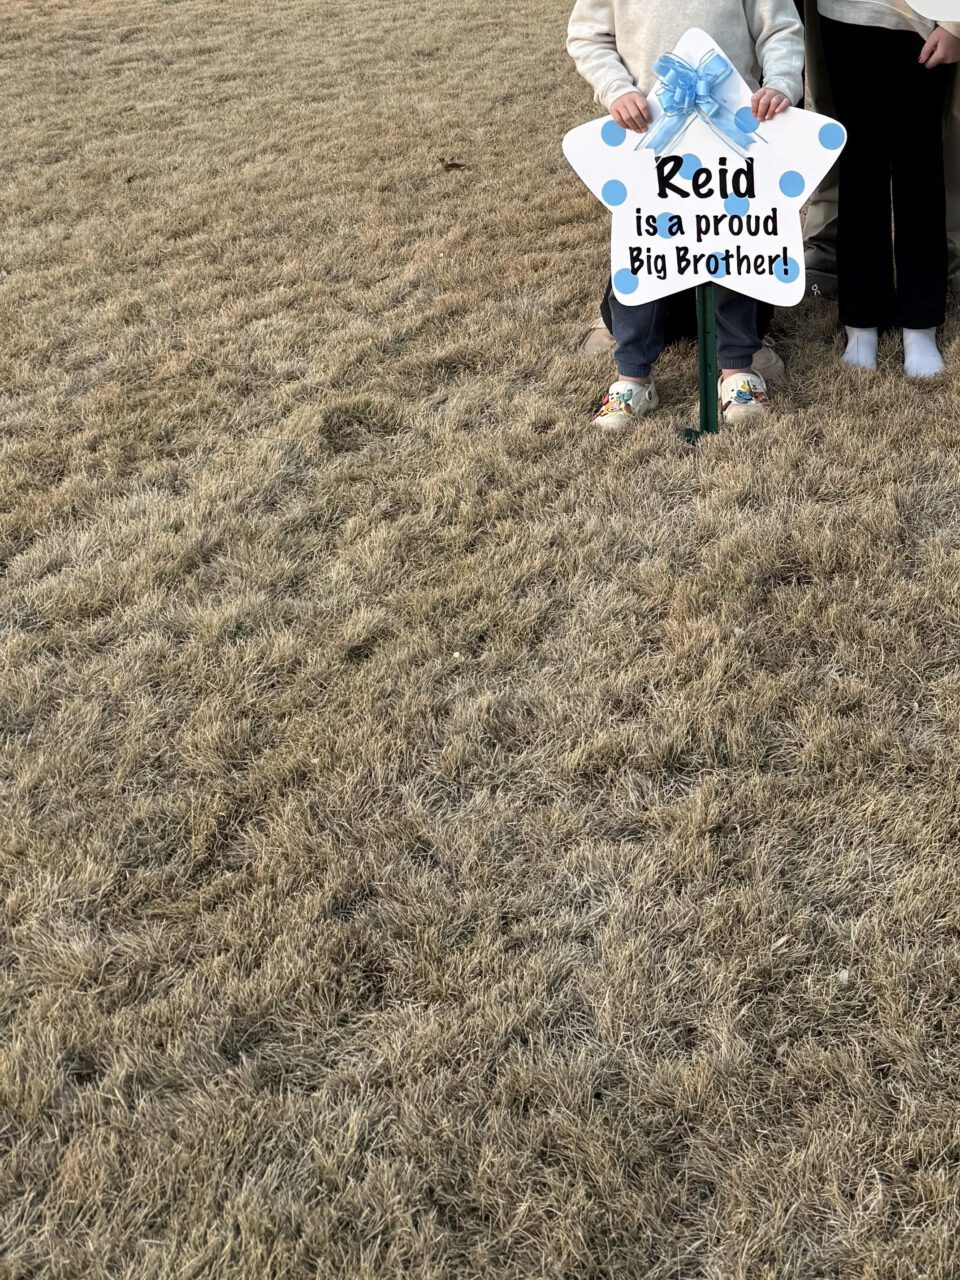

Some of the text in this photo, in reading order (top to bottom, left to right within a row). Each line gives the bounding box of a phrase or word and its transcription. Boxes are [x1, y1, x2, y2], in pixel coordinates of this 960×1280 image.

[654, 155, 756, 200] Reid
[635, 207, 779, 243] is a proud
[628, 245, 789, 281] Big Brother!
